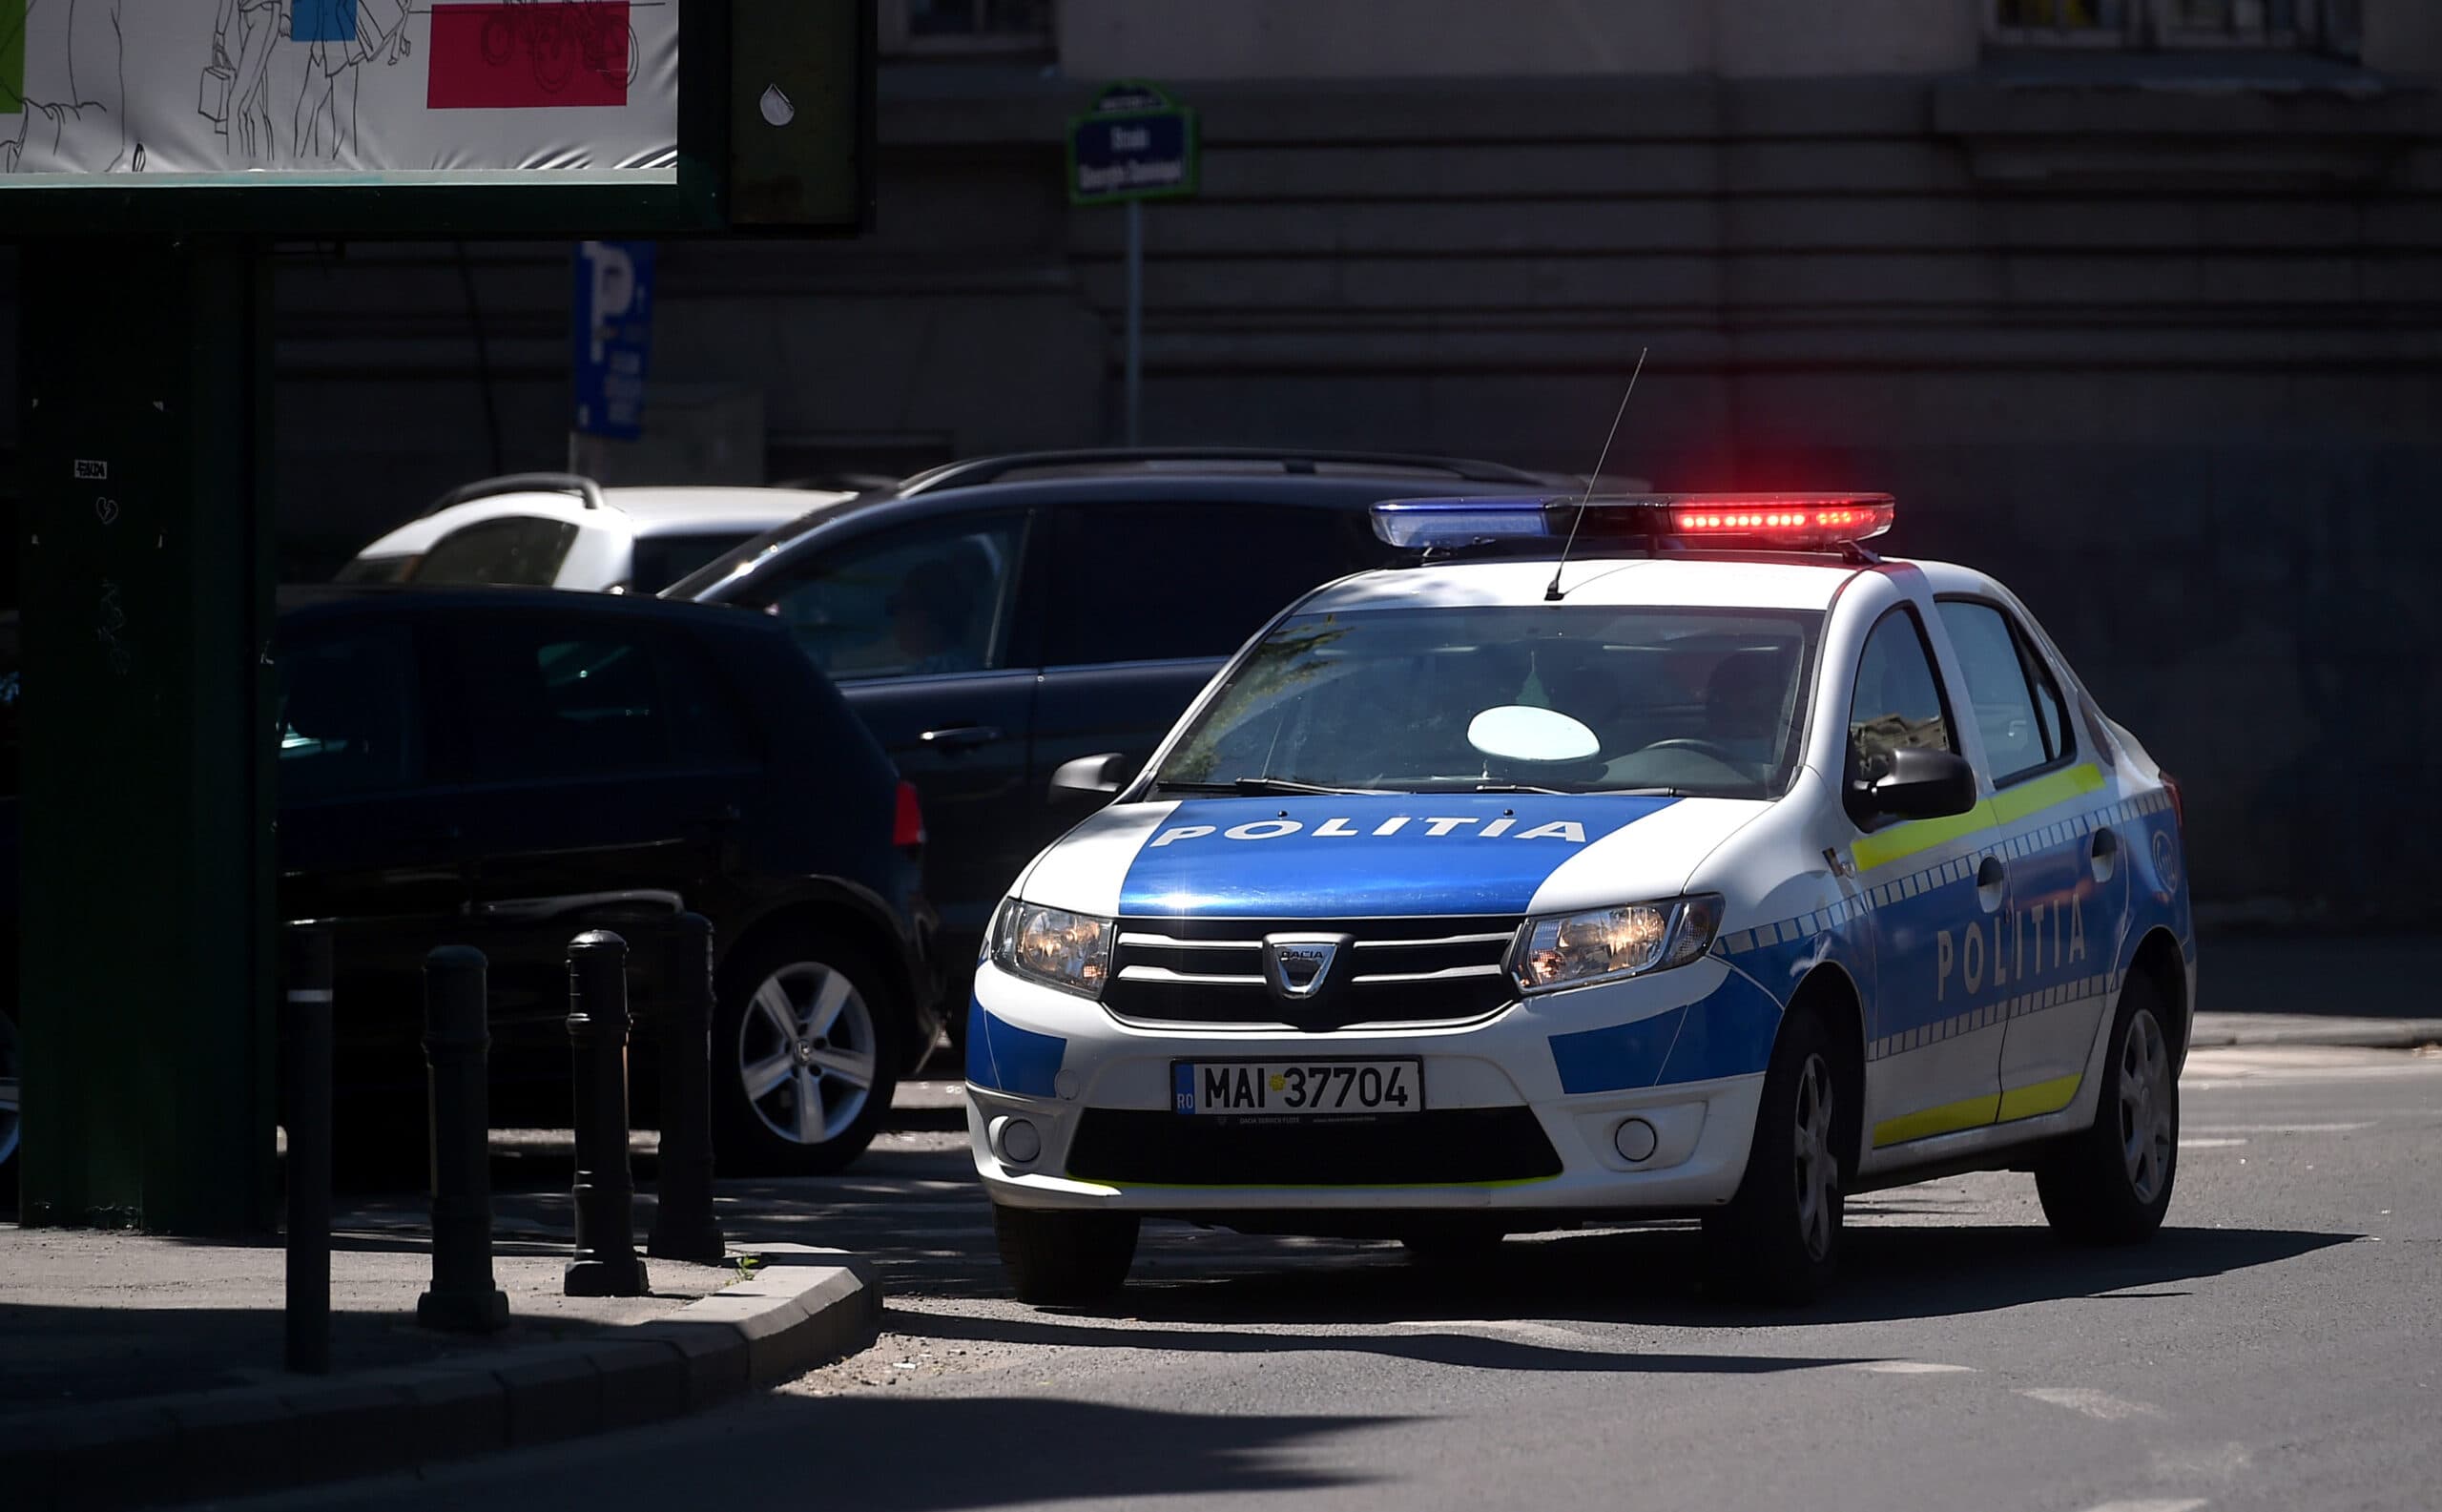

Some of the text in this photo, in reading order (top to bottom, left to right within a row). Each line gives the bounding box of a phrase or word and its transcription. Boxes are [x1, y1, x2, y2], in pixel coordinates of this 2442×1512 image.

[581, 240, 635, 364] P
[1149, 817, 1587, 848] POLITIA
[1282, 950, 1324, 959] DACIA
[1937, 893, 2086, 1003] POLITIA
[1176, 1093, 1193, 1109] RO
[1205, 1066, 1409, 1108] MAI 37704
